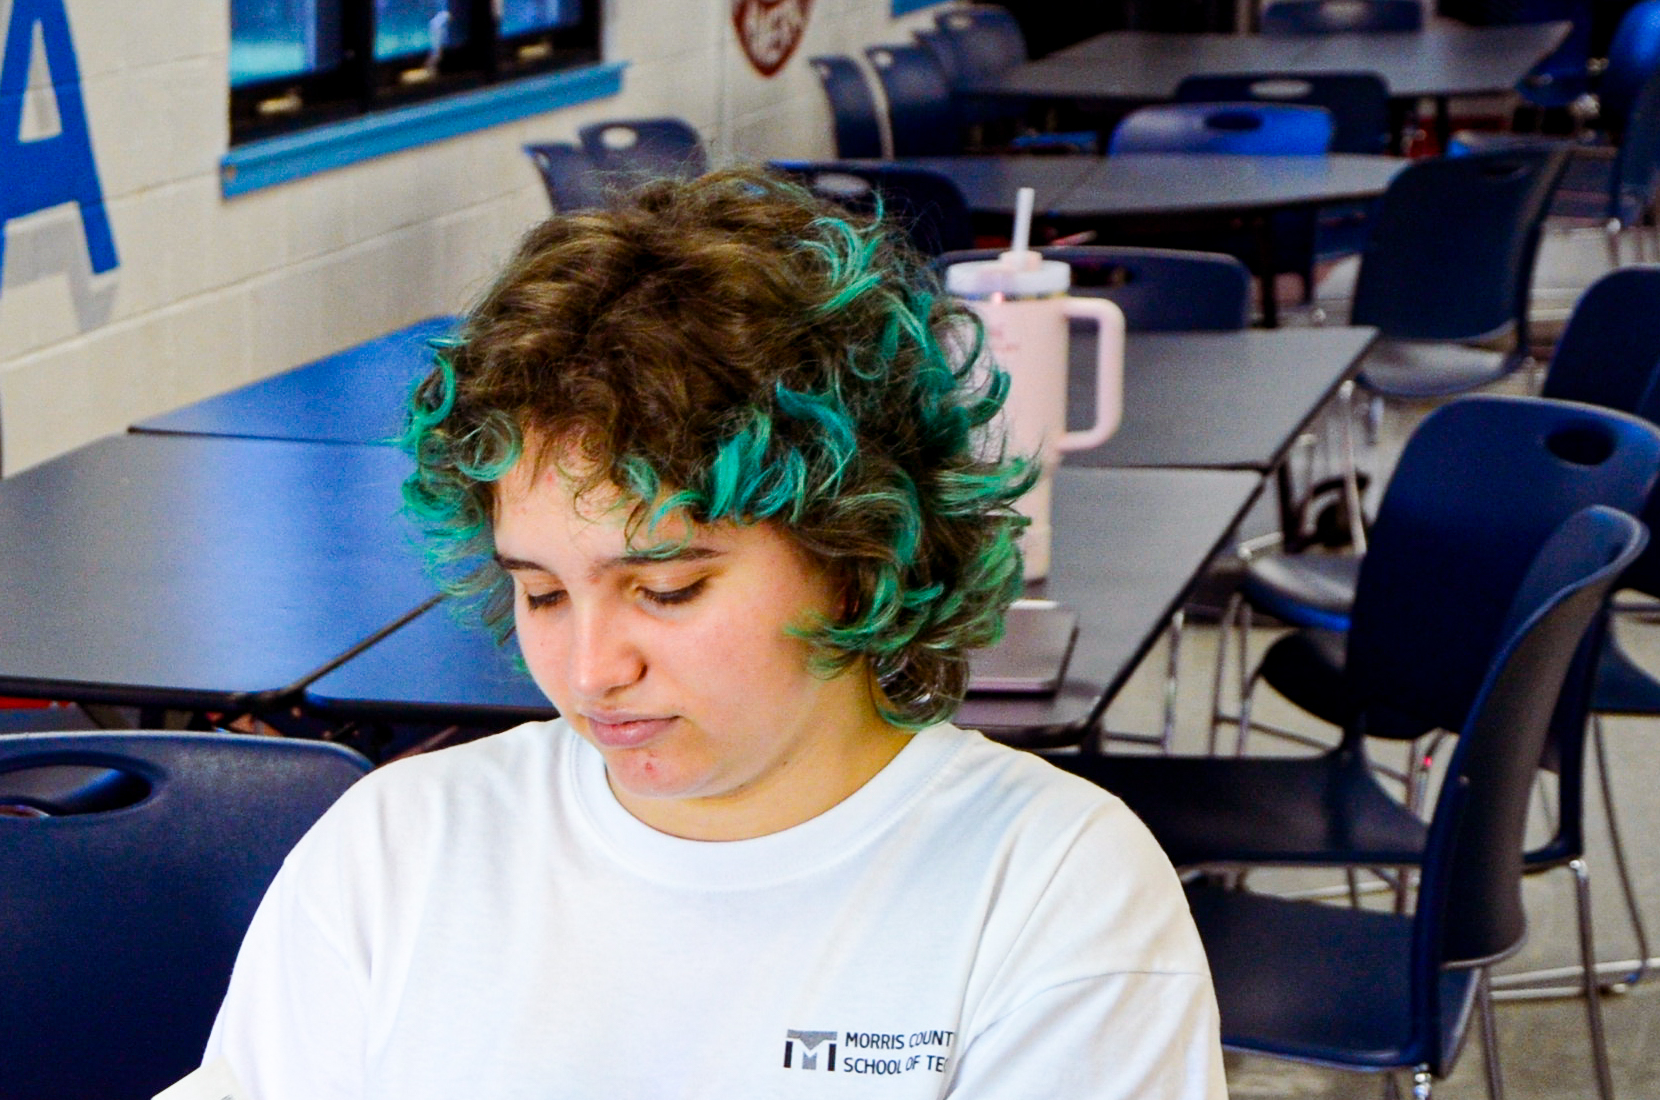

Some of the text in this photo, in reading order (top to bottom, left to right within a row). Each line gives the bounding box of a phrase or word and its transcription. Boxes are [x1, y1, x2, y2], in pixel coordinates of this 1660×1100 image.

[845, 1032, 905, 1050] MORRIS
[843, 1057, 902, 1075] SCHOOL
[905, 1055, 921, 1071] OF
